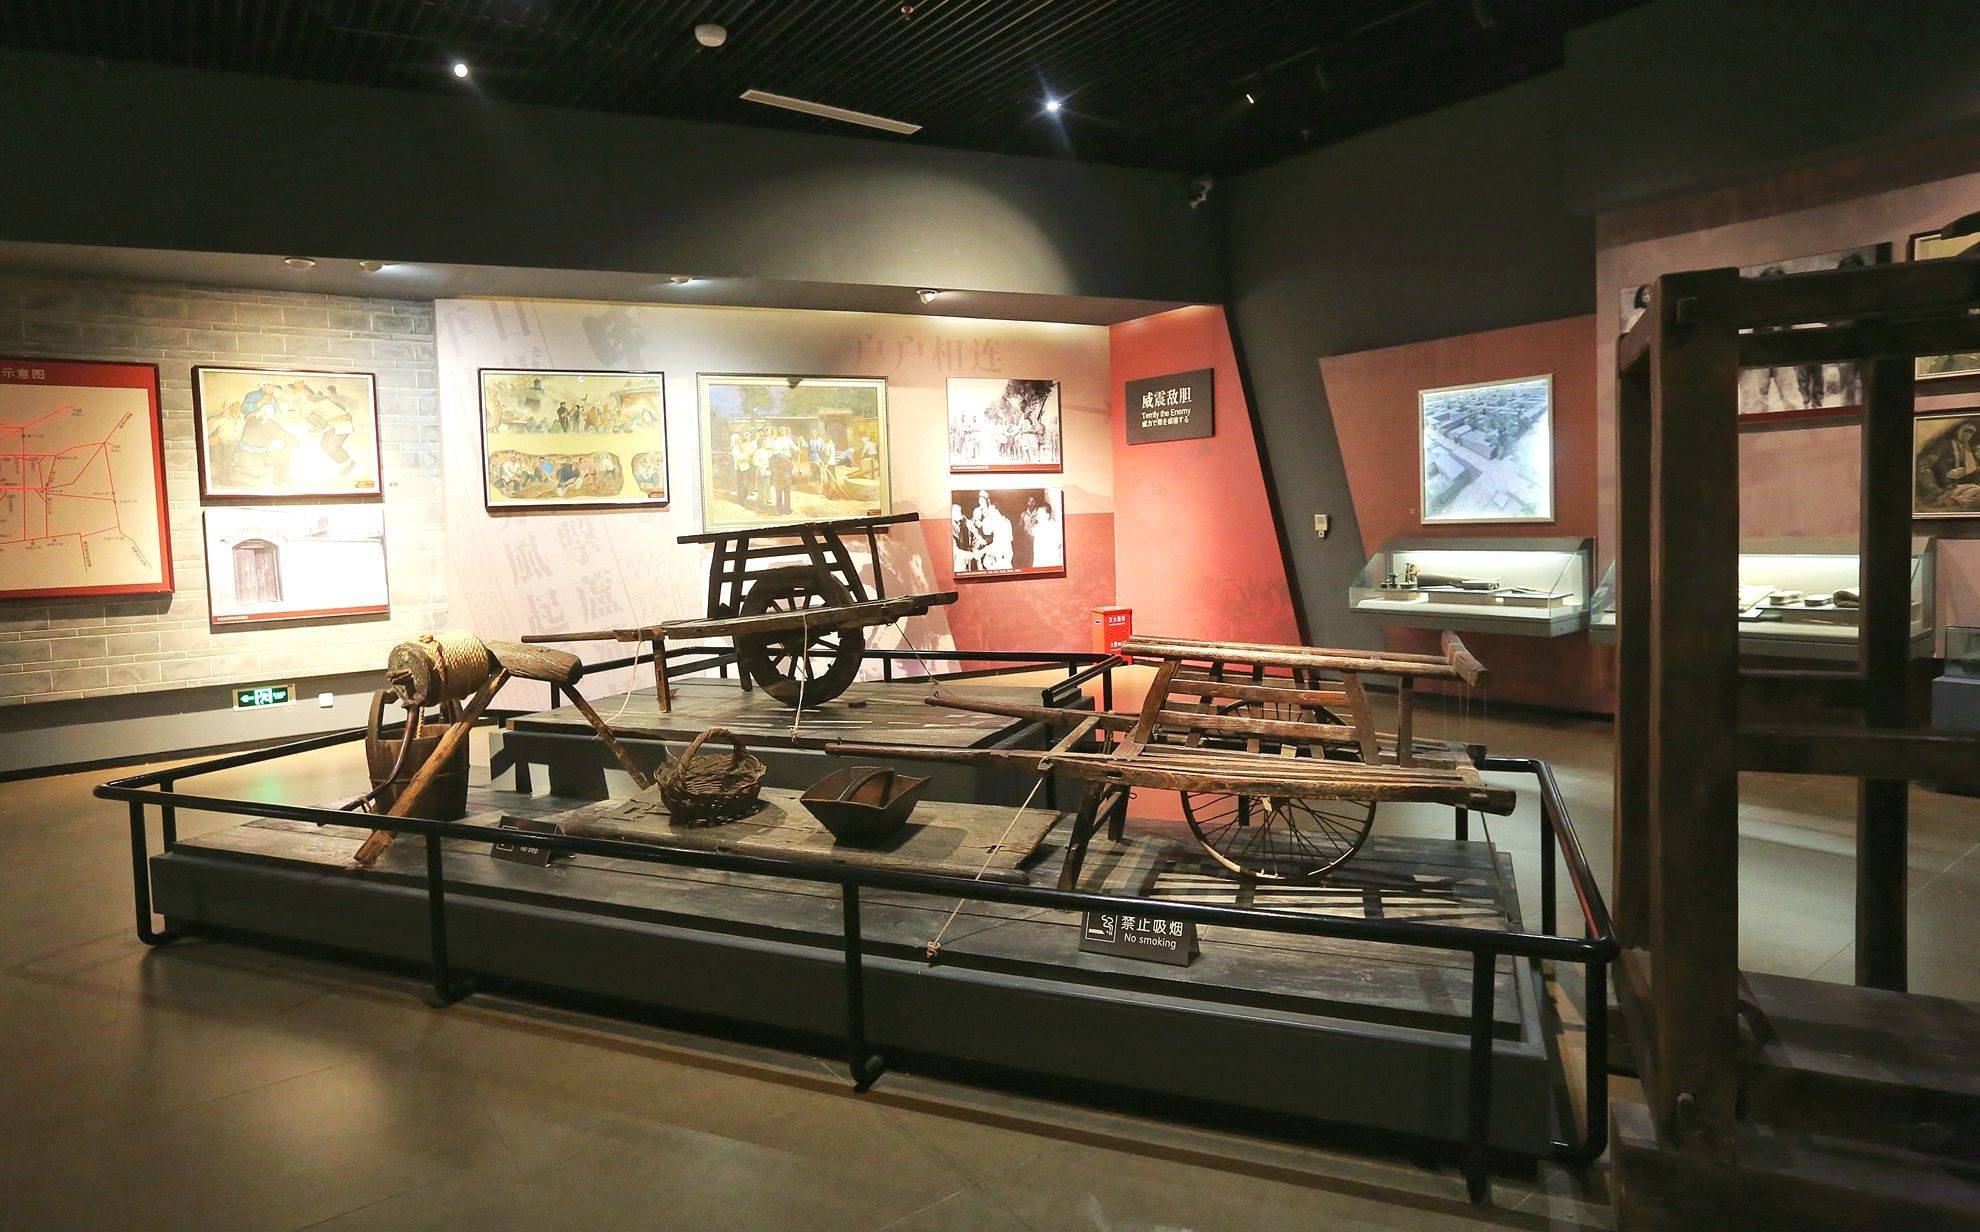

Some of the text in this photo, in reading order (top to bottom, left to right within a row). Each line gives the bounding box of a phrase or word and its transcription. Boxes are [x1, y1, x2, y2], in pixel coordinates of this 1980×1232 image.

[854, 332, 1001, 373] 户户相连
[1, 367, 45, 380] 示意图
[1142, 387, 1192, 409] 威震敌胆
[1142, 408, 1192, 420] Terrify the Enemy
[1121, 915, 1183, 937] 禁止吸烟
[1124, 932, 1177, 951] No smoking
